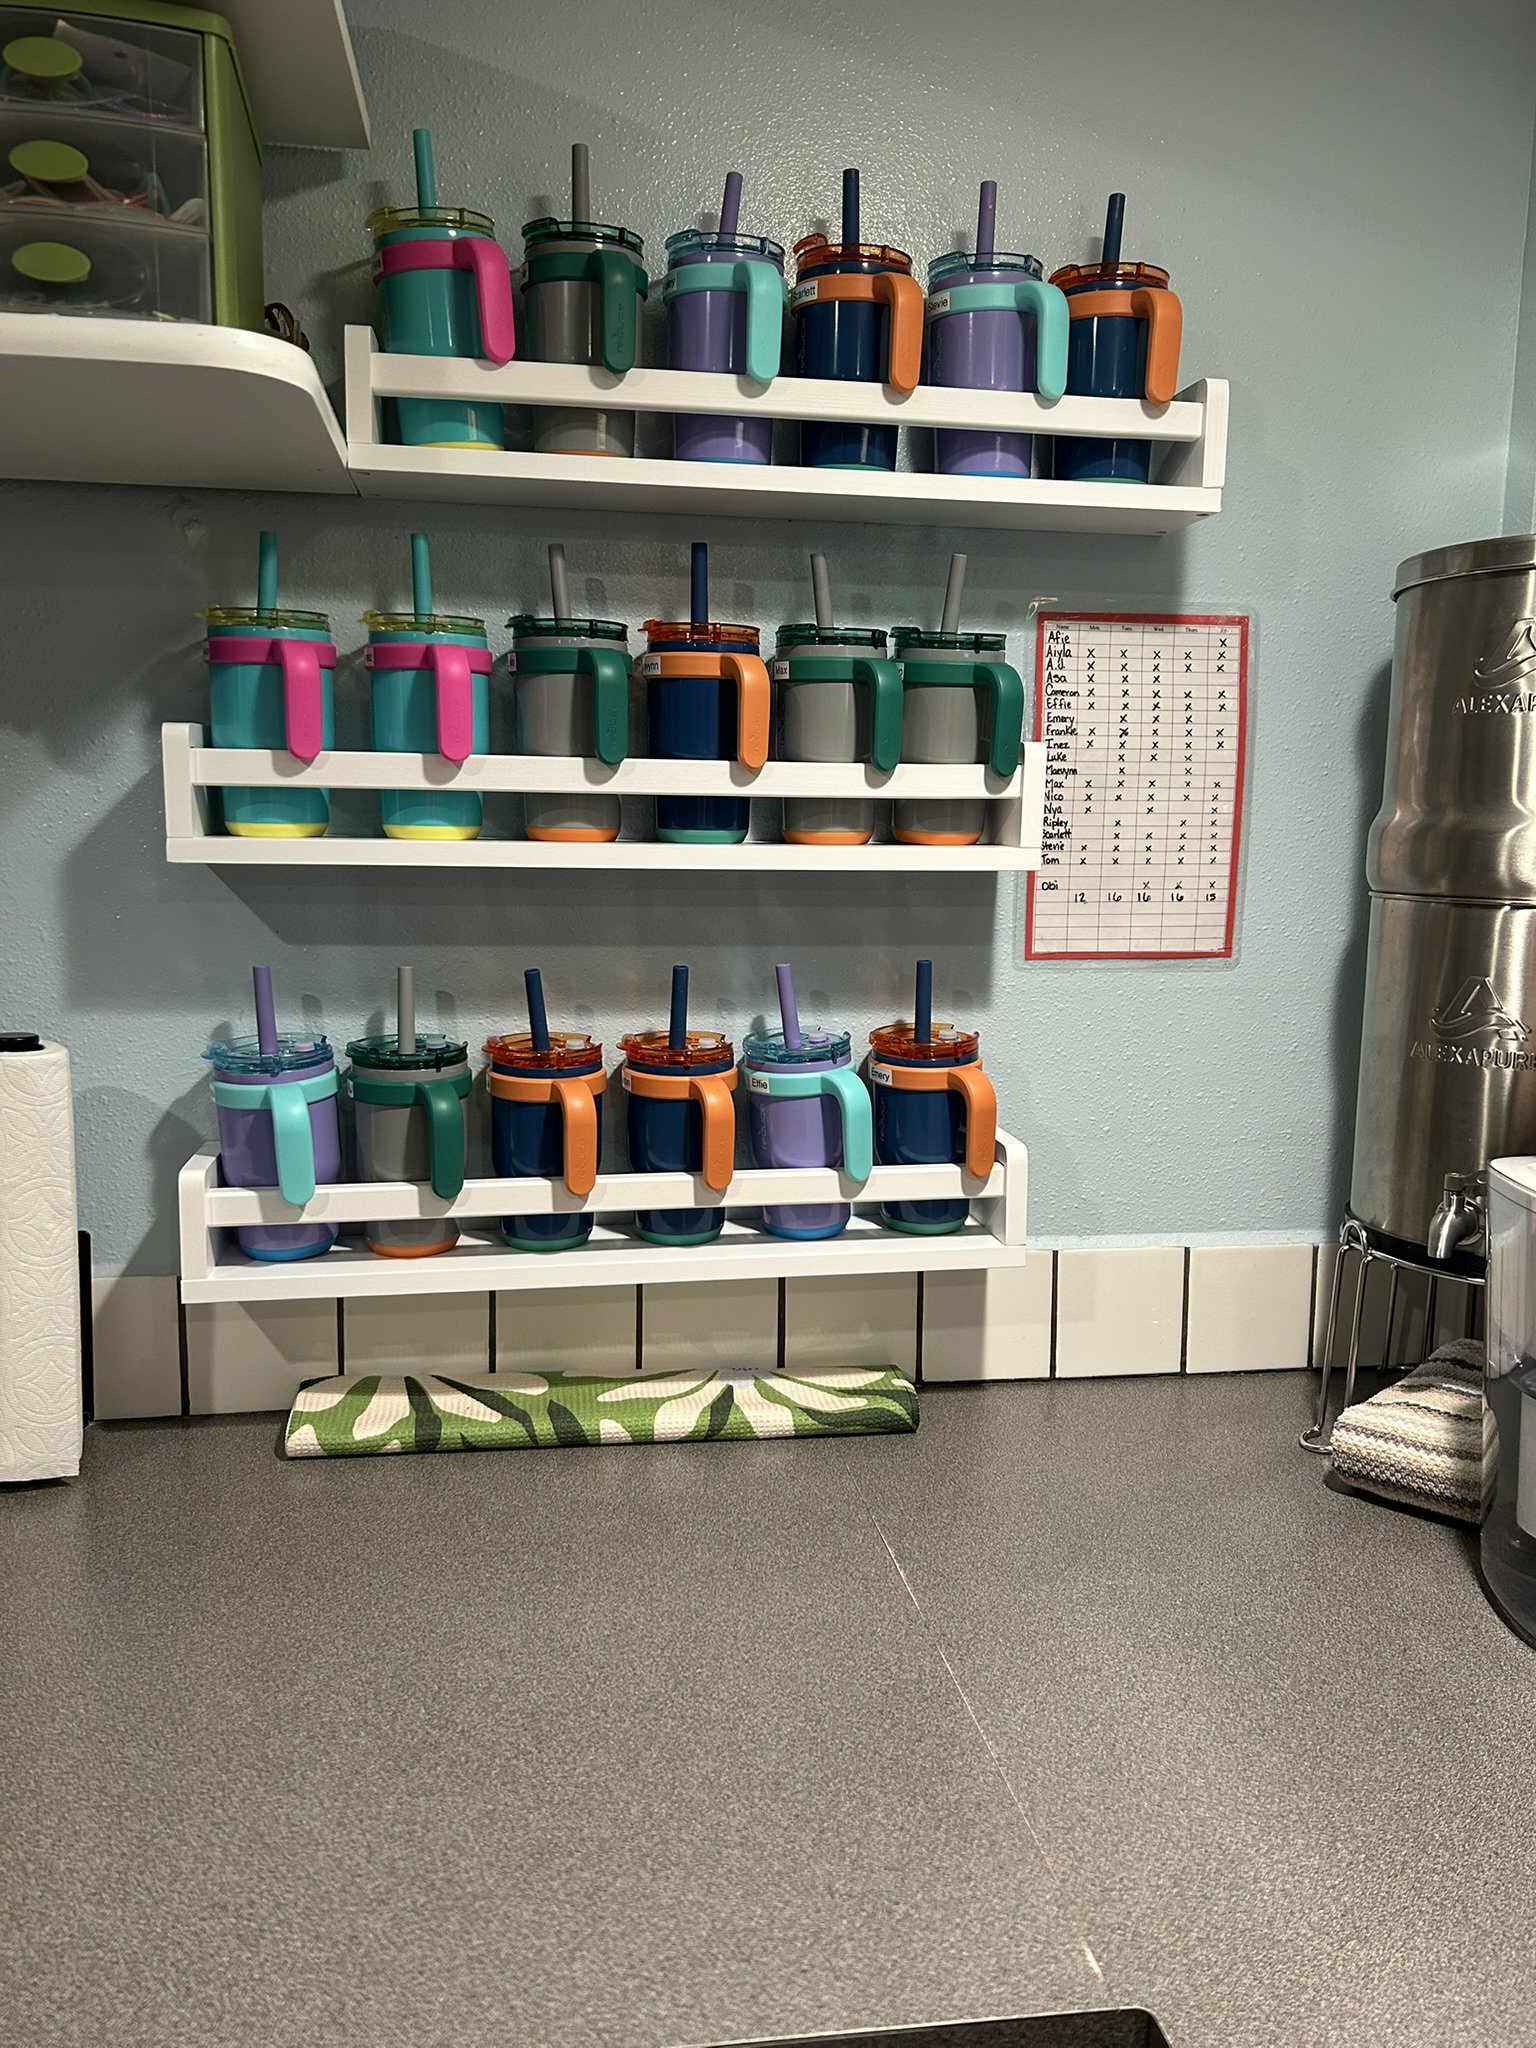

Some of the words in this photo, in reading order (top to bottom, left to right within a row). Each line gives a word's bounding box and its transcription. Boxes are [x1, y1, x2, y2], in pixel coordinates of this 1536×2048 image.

[928, 298, 948, 313] Stevie
[1047, 631, 1071, 645] Afie
[1046, 645, 1072, 663] Aiyla
[776, 664, 788, 675] Max
[1047, 672, 1068, 684] Asa
[1045, 683, 1080, 697] Cameron
[1047, 698, 1072, 710] Effie
[1045, 738, 1071, 749] Inez
[1045, 778, 1064, 789] Max
[1044, 802, 1063, 819] Nya
[1043, 815, 1069, 831] Ripley
[1041, 853, 1060, 865] Tom
[1041, 880, 1059, 891] Obi
[1074, 893, 1086, 903] 12
[1108, 892, 1122, 902] 16
[1137, 892, 1151, 902] 16
[871, 1066, 890, 1082] Emery
[752, 1077, 768, 1089] Effie
